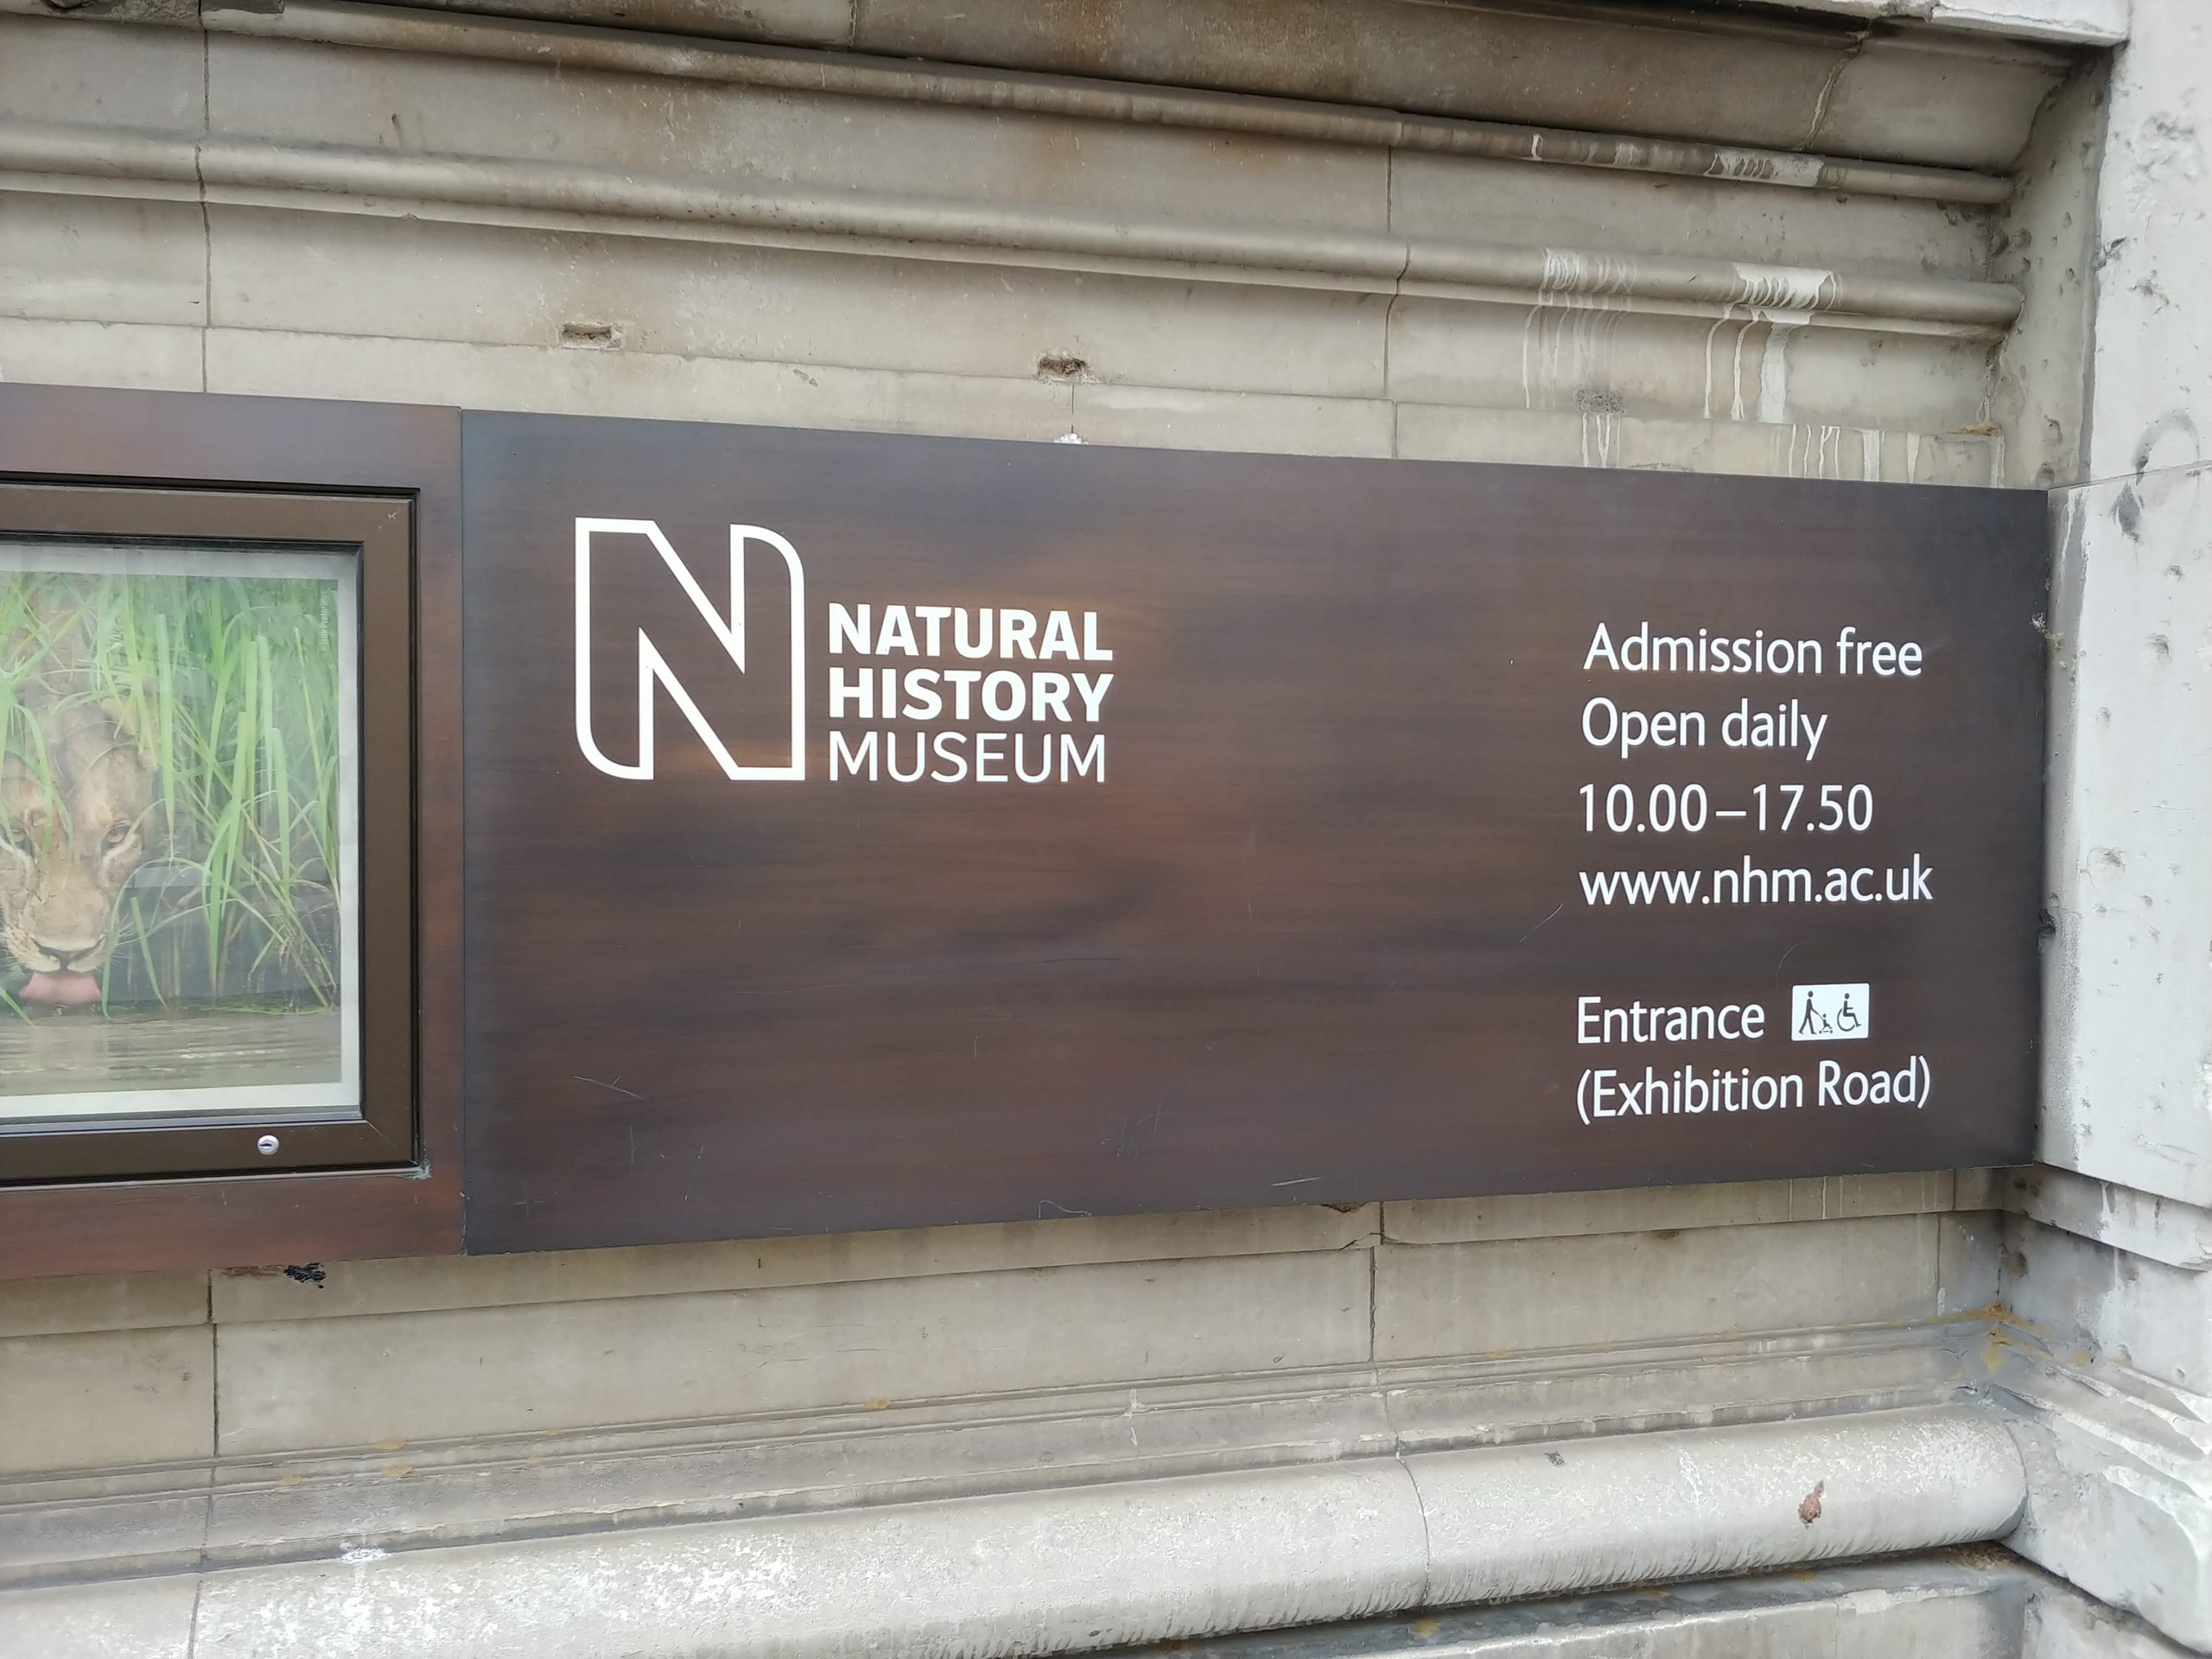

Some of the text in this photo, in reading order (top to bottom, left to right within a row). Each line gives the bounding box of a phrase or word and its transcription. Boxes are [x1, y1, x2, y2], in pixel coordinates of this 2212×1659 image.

[828, 602, 1115, 663] NATURAL
[1582, 620, 1923, 677] Admission free
[828, 666, 1116, 724] HISTORY
[828, 730, 1106, 785] MUSEUM
[1581, 696, 1829, 762] Open daily
[1578, 853, 1935, 906] www.nhm.ac.uk
[1576, 995, 1765, 1046] Entrance
[1575, 1055, 1932, 1127] (Exhibition Road)
